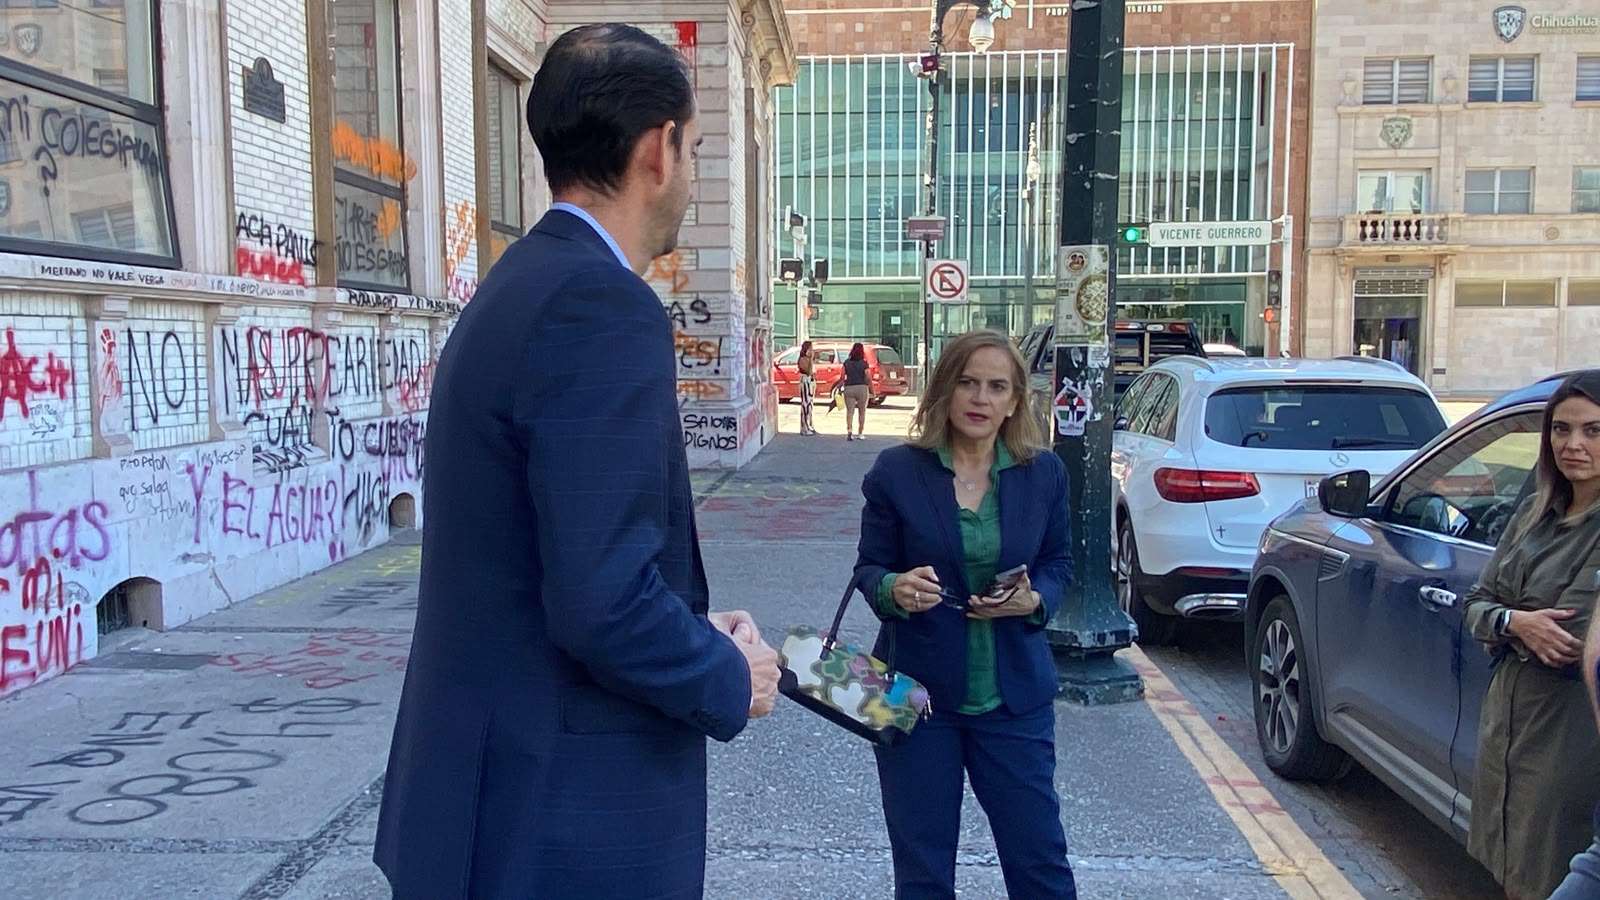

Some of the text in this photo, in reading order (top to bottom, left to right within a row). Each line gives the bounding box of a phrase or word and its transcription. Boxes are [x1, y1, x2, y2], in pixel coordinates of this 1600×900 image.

[1531, 14, 1598, 28] Chihuahua
[1160, 227, 1262, 240] VICENTE GUERRERO
[108, 269, 135, 281] VALE
[126, 326, 187, 432] NO
